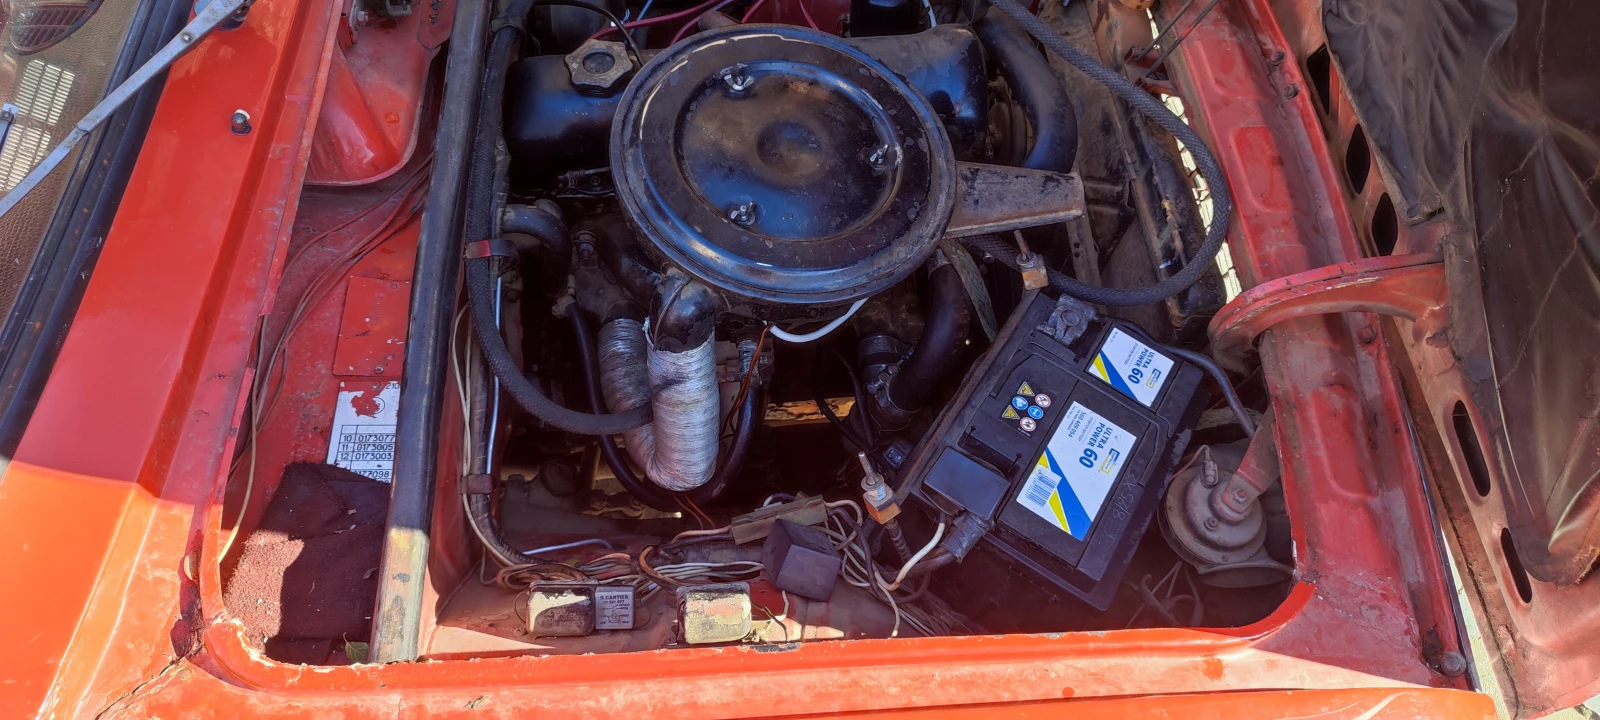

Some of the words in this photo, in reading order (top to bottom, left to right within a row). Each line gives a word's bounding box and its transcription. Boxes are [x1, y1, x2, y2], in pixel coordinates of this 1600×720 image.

[1134, 347, 1149, 367] POWER
[1142, 351, 1155, 369] ULTRA
[1128, 367, 1143, 384] 60
[358, 434, 396, 442] 0173077
[1087, 422, 1105, 447] POWER
[1096, 427, 1113, 449] ULTRA
[340, 452, 350, 460] 12
[355, 452, 392, 460] 0173003
[342, 443, 349, 451] 11
[356, 443, 393, 451] 0173005
[1079, 447, 1098, 468] 60
